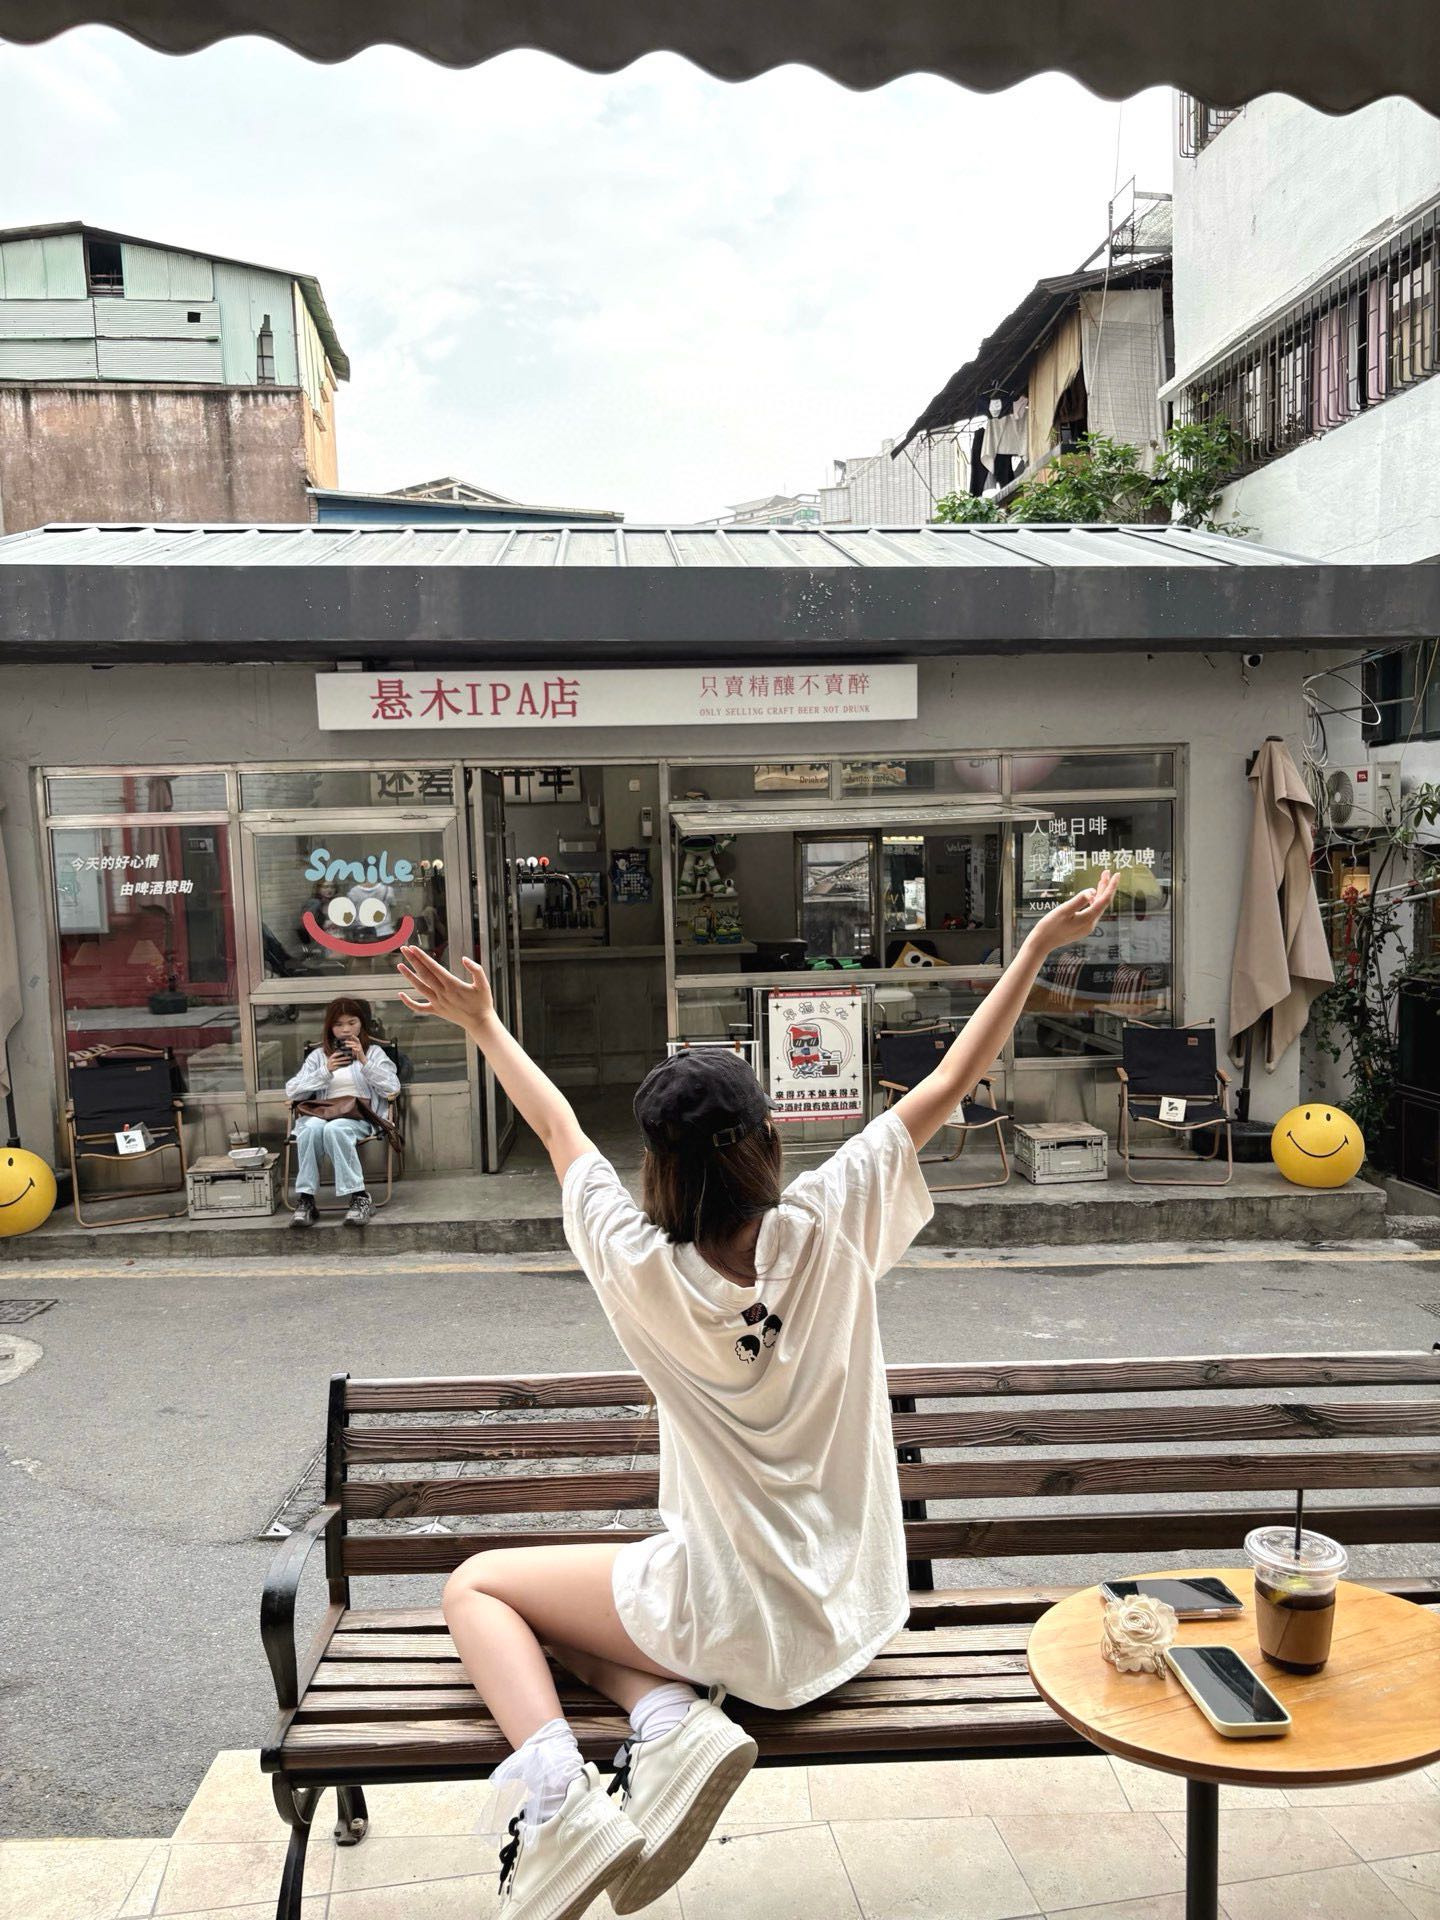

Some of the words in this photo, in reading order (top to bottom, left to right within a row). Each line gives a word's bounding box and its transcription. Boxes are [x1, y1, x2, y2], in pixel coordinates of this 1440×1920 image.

[700, 672, 870, 698] 只賣精釀不賣醉
[369, 677, 581, 721] 悬木IPA店
[700, 707, 722, 717] ONLY
[725, 707, 764, 716] SELLING
[767, 706, 794, 716] CRAFT
[798, 706, 820, 715] BEER
[823, 705, 839, 714] NOT
[843, 704, 871, 713] DRUNK
[71, 854, 160, 871] 今天的好心情
[304, 847, 415, 885] Smile
[120, 880, 194, 896] 由啤酒赞助
